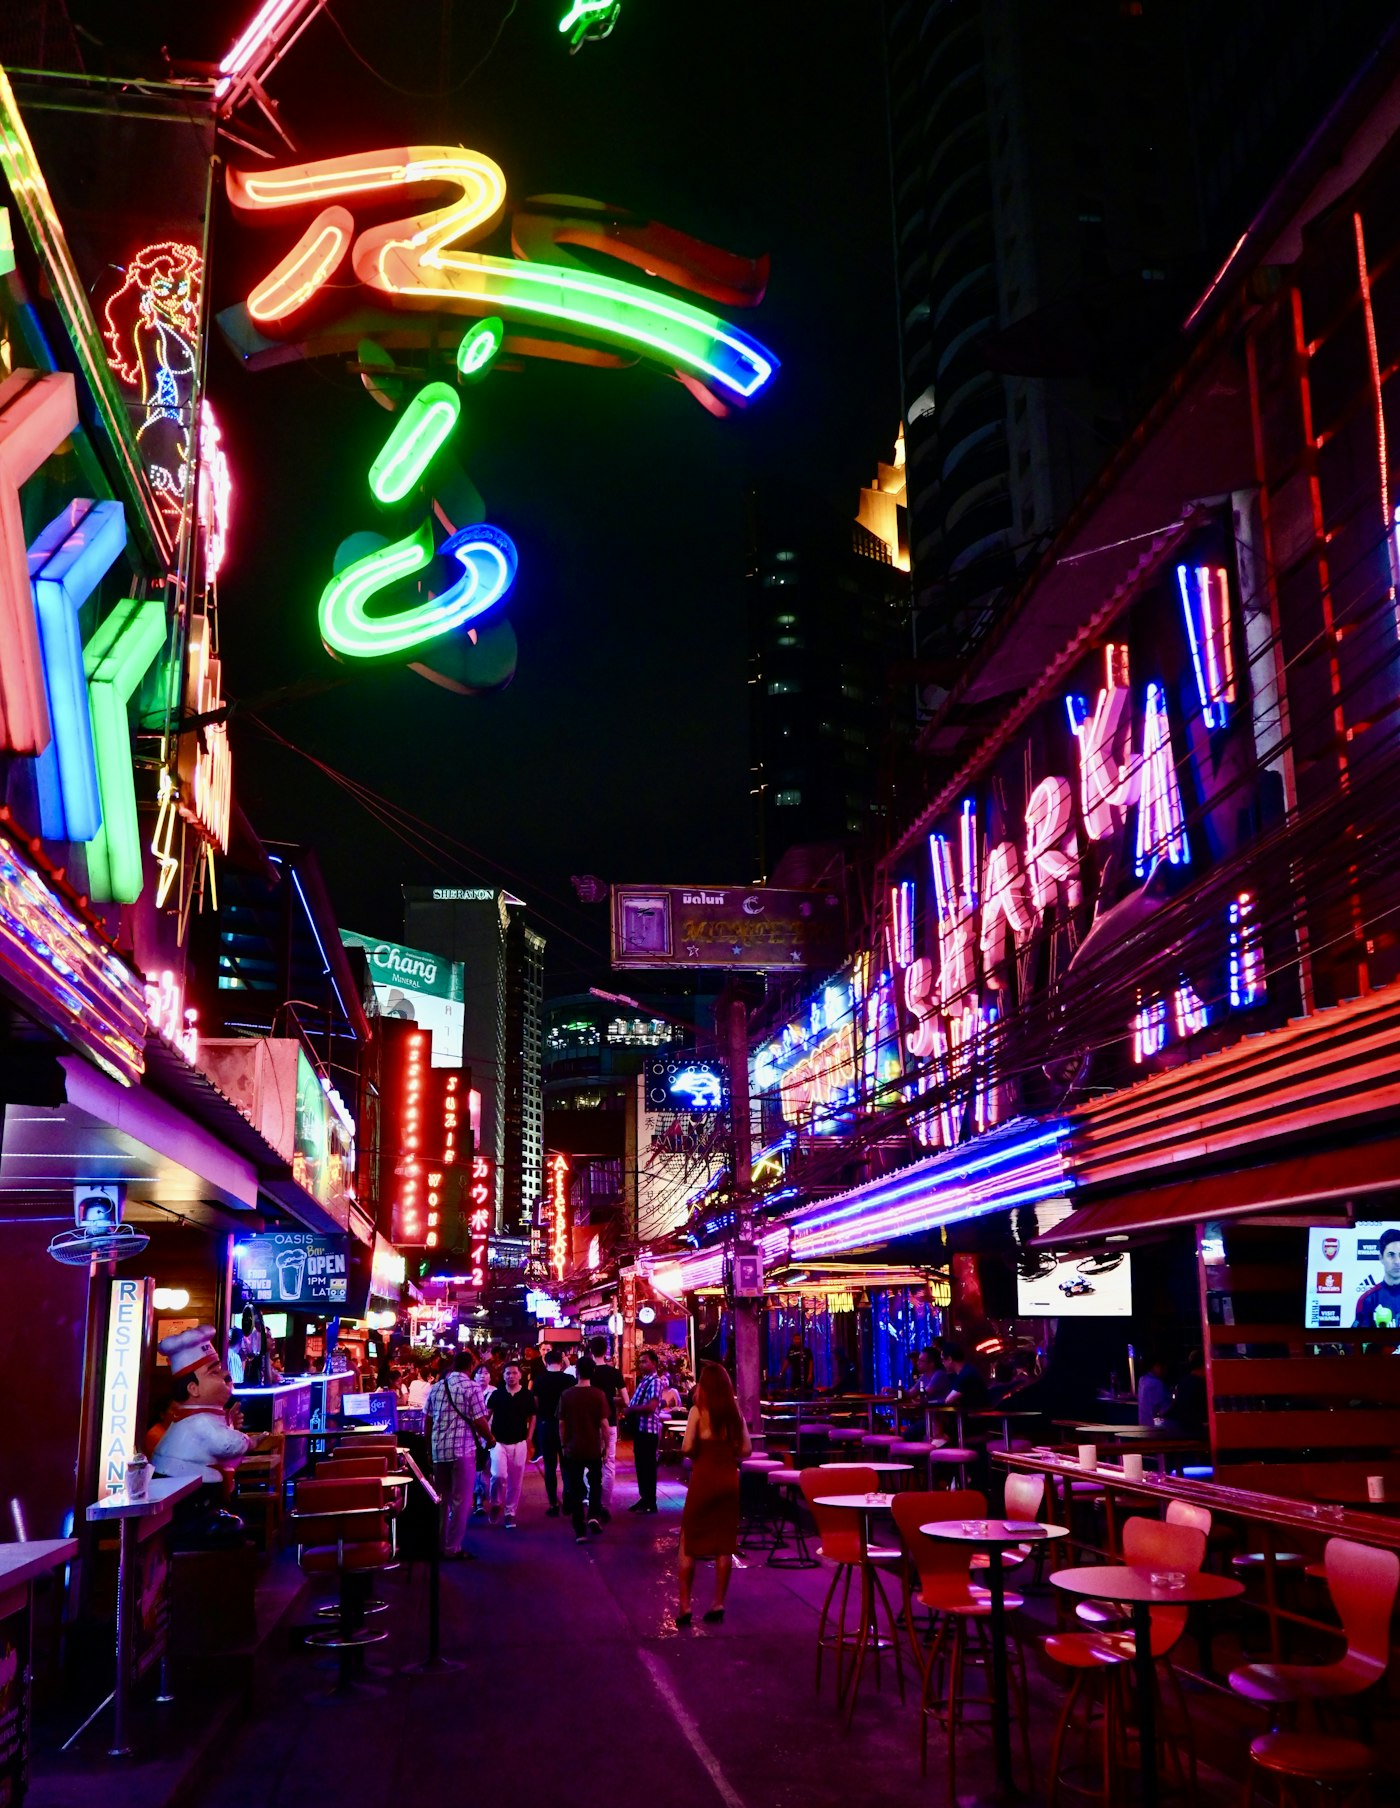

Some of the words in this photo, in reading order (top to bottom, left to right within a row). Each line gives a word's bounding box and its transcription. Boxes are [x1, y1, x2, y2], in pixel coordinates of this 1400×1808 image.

[433, 889, 494, 900] SHERATON
[373, 944, 438, 985] Chang
[444, 1076, 458, 1162] SUZIE
[427, 1173, 441, 1246] WONG
[471, 1158, 489, 1286] カウボーイ2
[274, 1234, 314, 1245] OASIS
[306, 1245, 325, 1257] Bar
[307, 1254, 346, 1275] OPEN
[307, 1277, 326, 1285] 1PM
[107, 1281, 137, 1494] RESTAURANT
